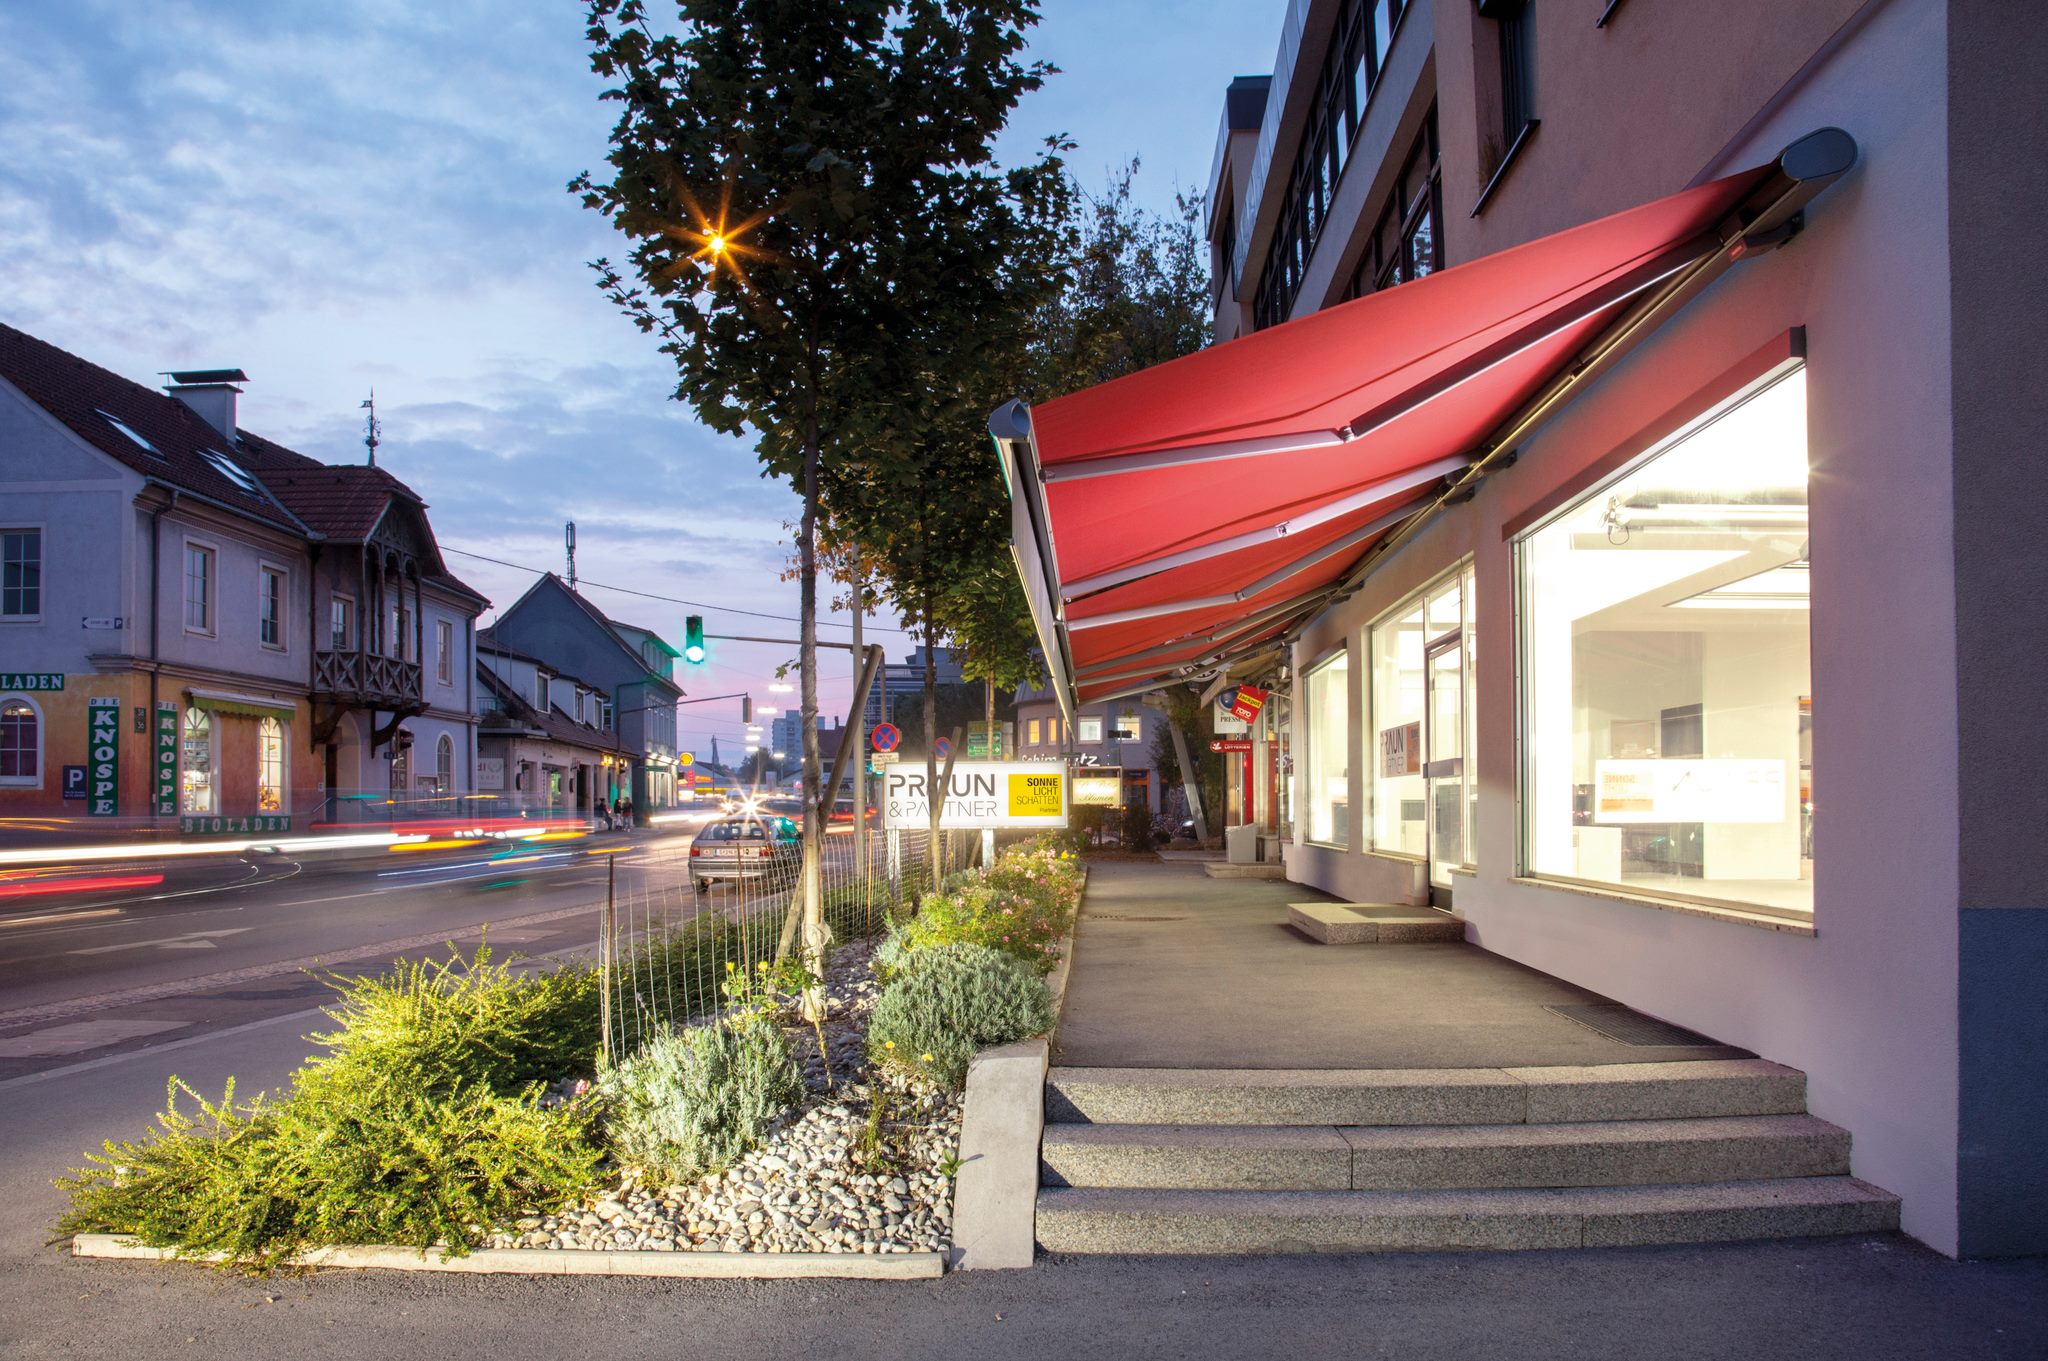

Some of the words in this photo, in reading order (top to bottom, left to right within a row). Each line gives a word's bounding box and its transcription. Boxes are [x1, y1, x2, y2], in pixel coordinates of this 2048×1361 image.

[1, 675, 63, 689] LADEN
[93, 710, 116, 814] KNOSPE
[160, 718, 175, 813] KNOSPE
[69, 769, 84, 788] P
[889, 773, 996, 797] PRUN
[1027, 777, 1058, 787] SONNE
[1033, 787, 1058, 796] LICHT
[1016, 795, 1059, 805] SCHATTEN
[888, 800, 997, 818] &PATNER
[184, 818, 289, 832] BIOLADEN
